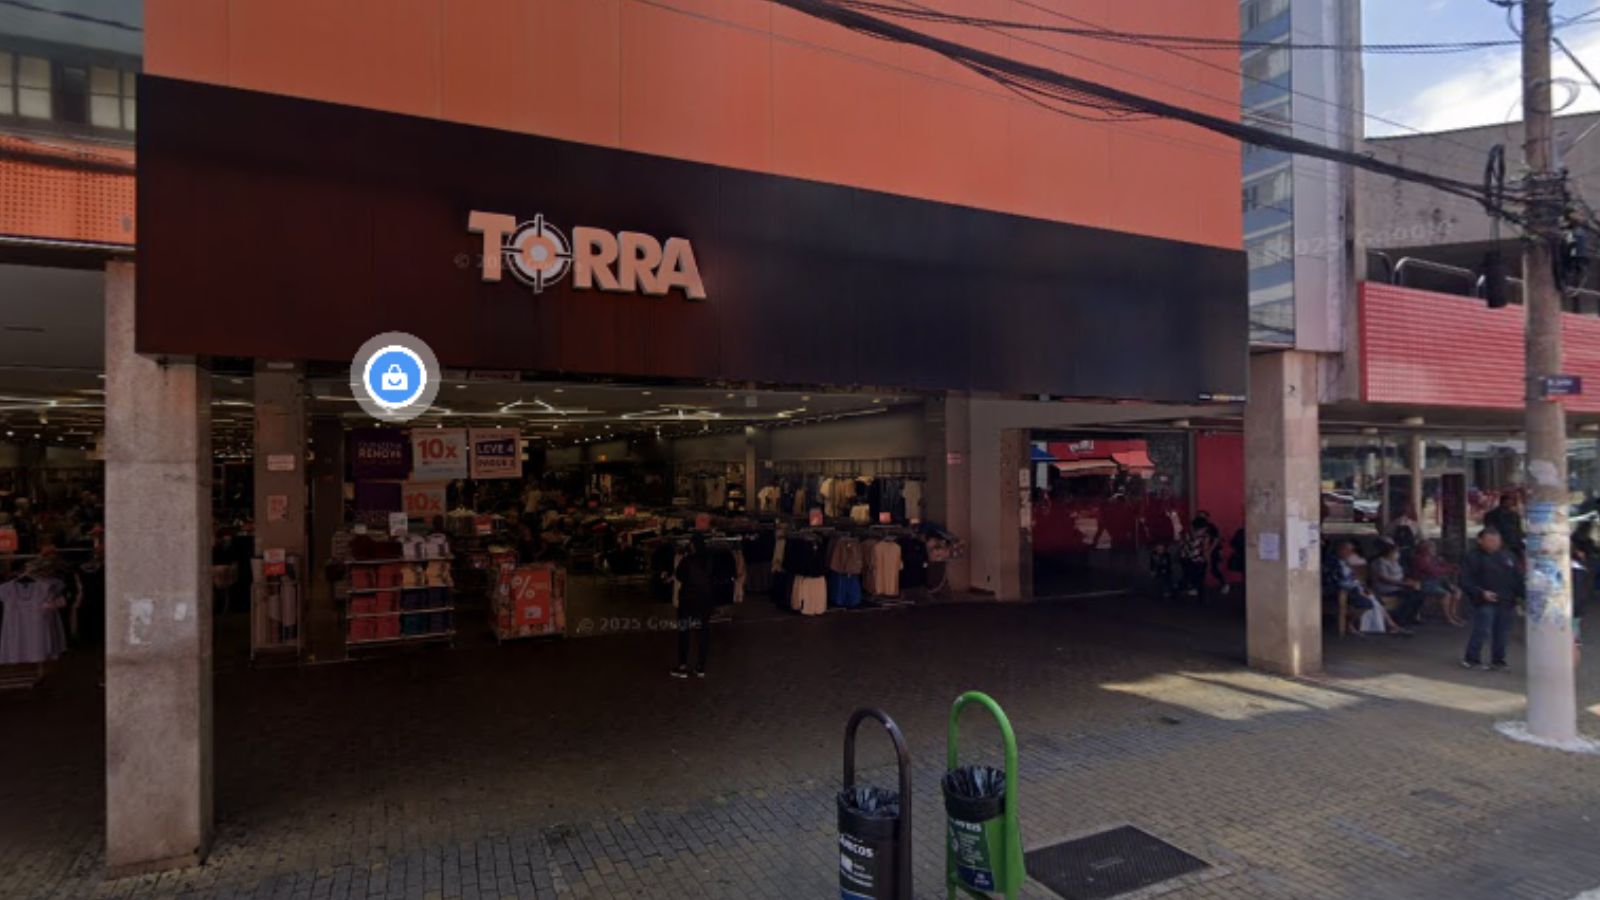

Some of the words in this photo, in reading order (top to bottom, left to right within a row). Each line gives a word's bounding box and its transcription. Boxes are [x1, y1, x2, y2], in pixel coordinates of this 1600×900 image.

[467, 209, 706, 299] TORRA
[417, 438, 457, 459] 10x
[405, 493, 441, 511] 10x
